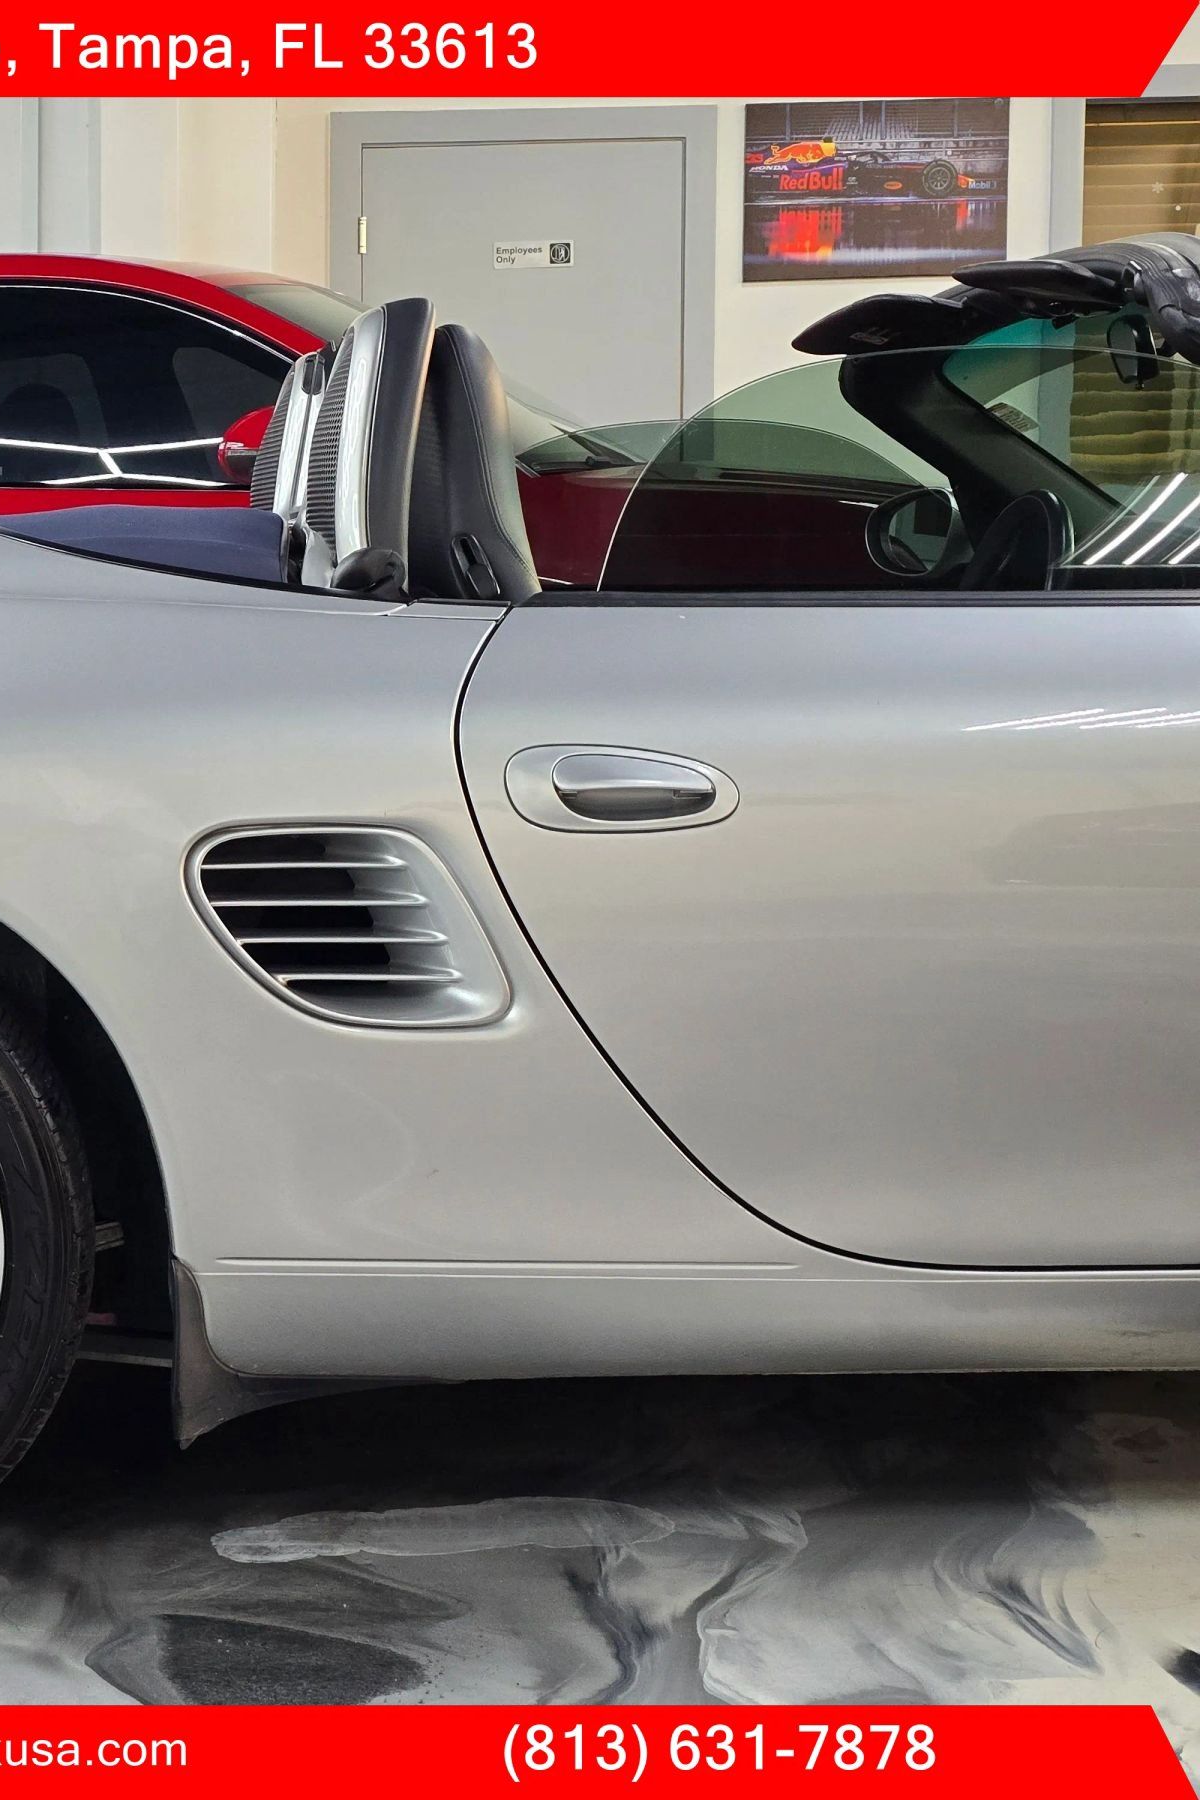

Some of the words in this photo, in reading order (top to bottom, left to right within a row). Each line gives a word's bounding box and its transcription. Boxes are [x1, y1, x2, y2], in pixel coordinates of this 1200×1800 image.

[749, 163, 789, 173] HONDA
[968, 179, 991, 190] Mobil
[496, 246, 543, 256] Employees
[496, 255, 516, 265] Only
